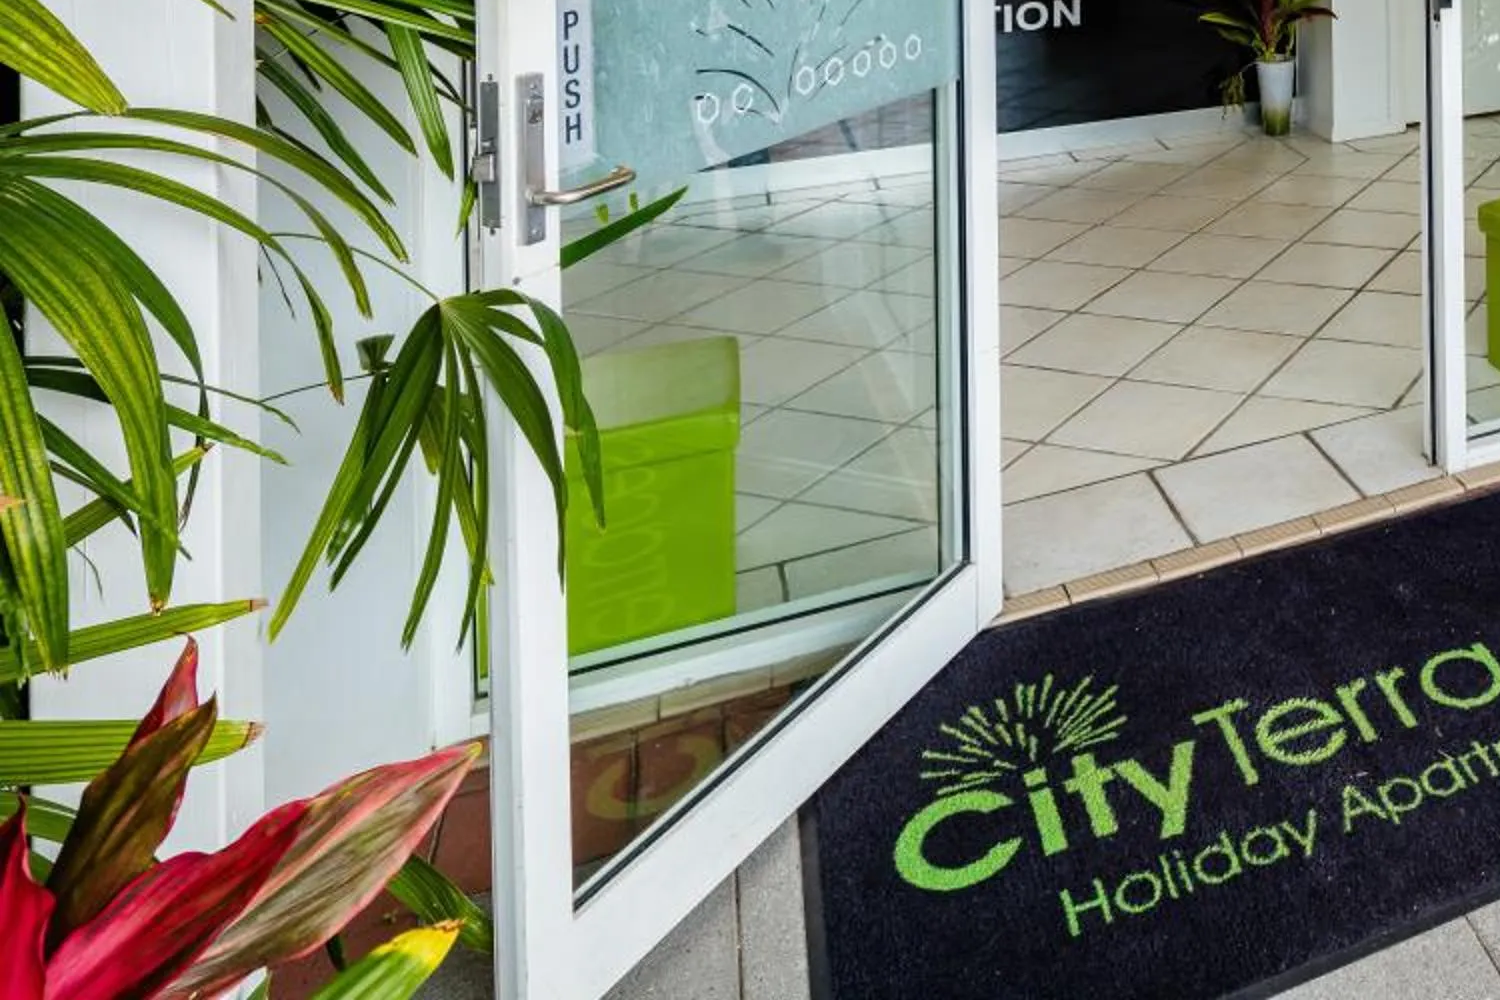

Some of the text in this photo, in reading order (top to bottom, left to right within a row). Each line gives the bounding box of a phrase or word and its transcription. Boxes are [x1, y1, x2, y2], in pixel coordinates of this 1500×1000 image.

[562, 9, 582, 145] PUSH
[894, 739, 1195, 893] City
[1060, 810, 1318, 937] Holiday
